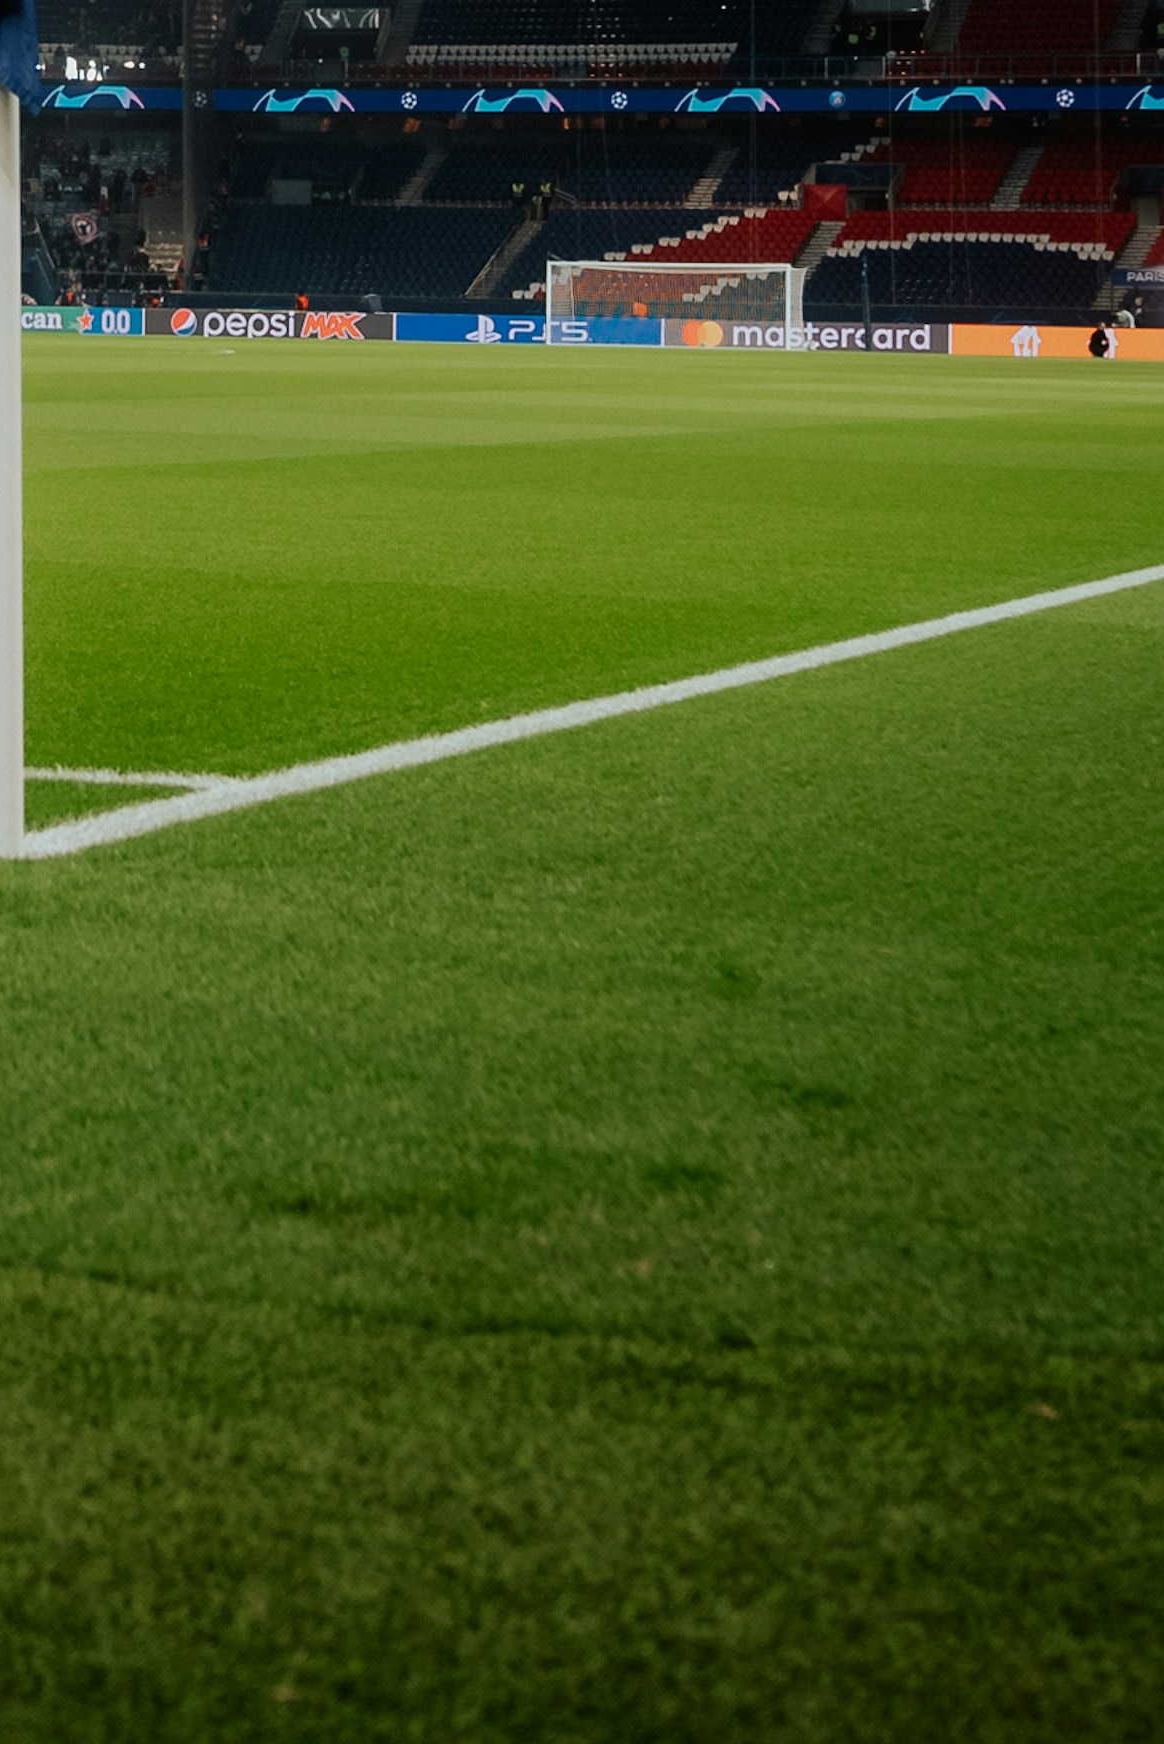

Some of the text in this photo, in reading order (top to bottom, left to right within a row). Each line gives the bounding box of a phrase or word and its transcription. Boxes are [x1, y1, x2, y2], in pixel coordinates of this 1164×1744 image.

[20, 312, 63, 330] can
[203, 310, 367, 340] pepsi MAX
[508, 319, 589, 342] PS5
[732, 321, 931, 351] mastercard
